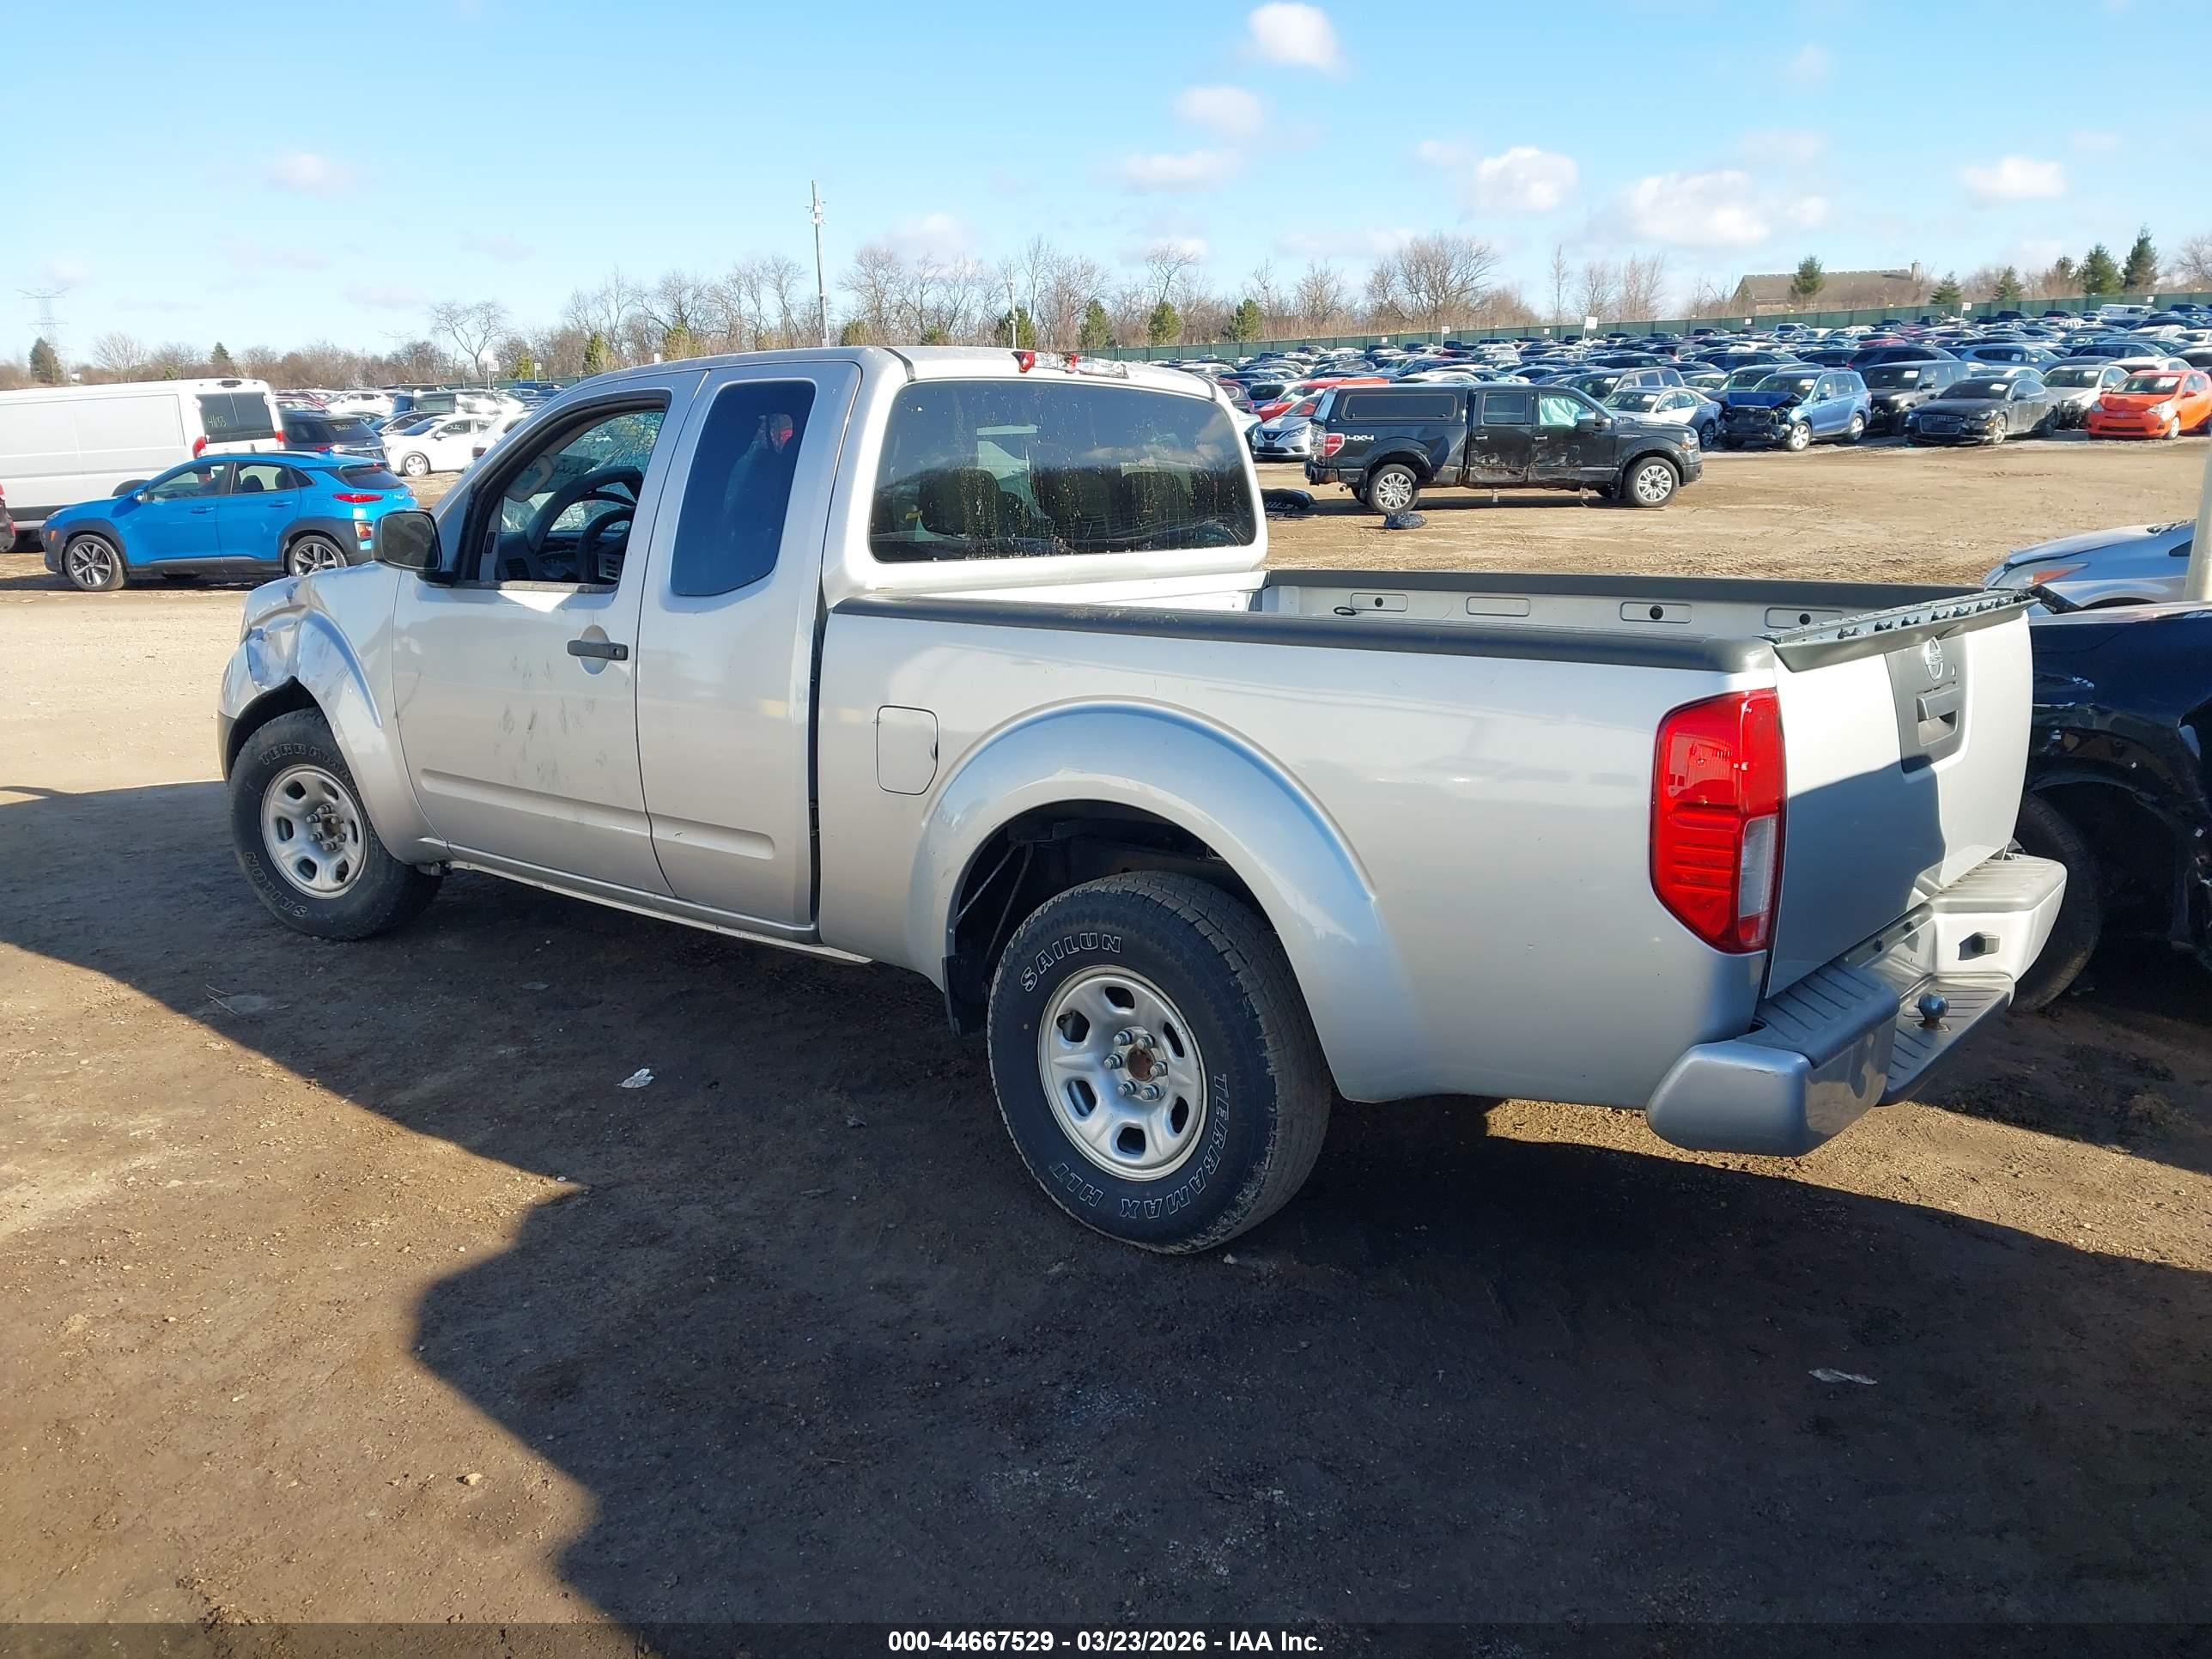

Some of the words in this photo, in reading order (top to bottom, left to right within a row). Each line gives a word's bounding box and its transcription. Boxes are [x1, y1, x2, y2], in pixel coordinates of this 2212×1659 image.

[245, 852, 308, 918] SAILUN
[1020, 933, 1121, 992] SAILUN
[1120, 1073, 1230, 1219] TERRAMAX
[1048, 1163, 1104, 1207] HLT
